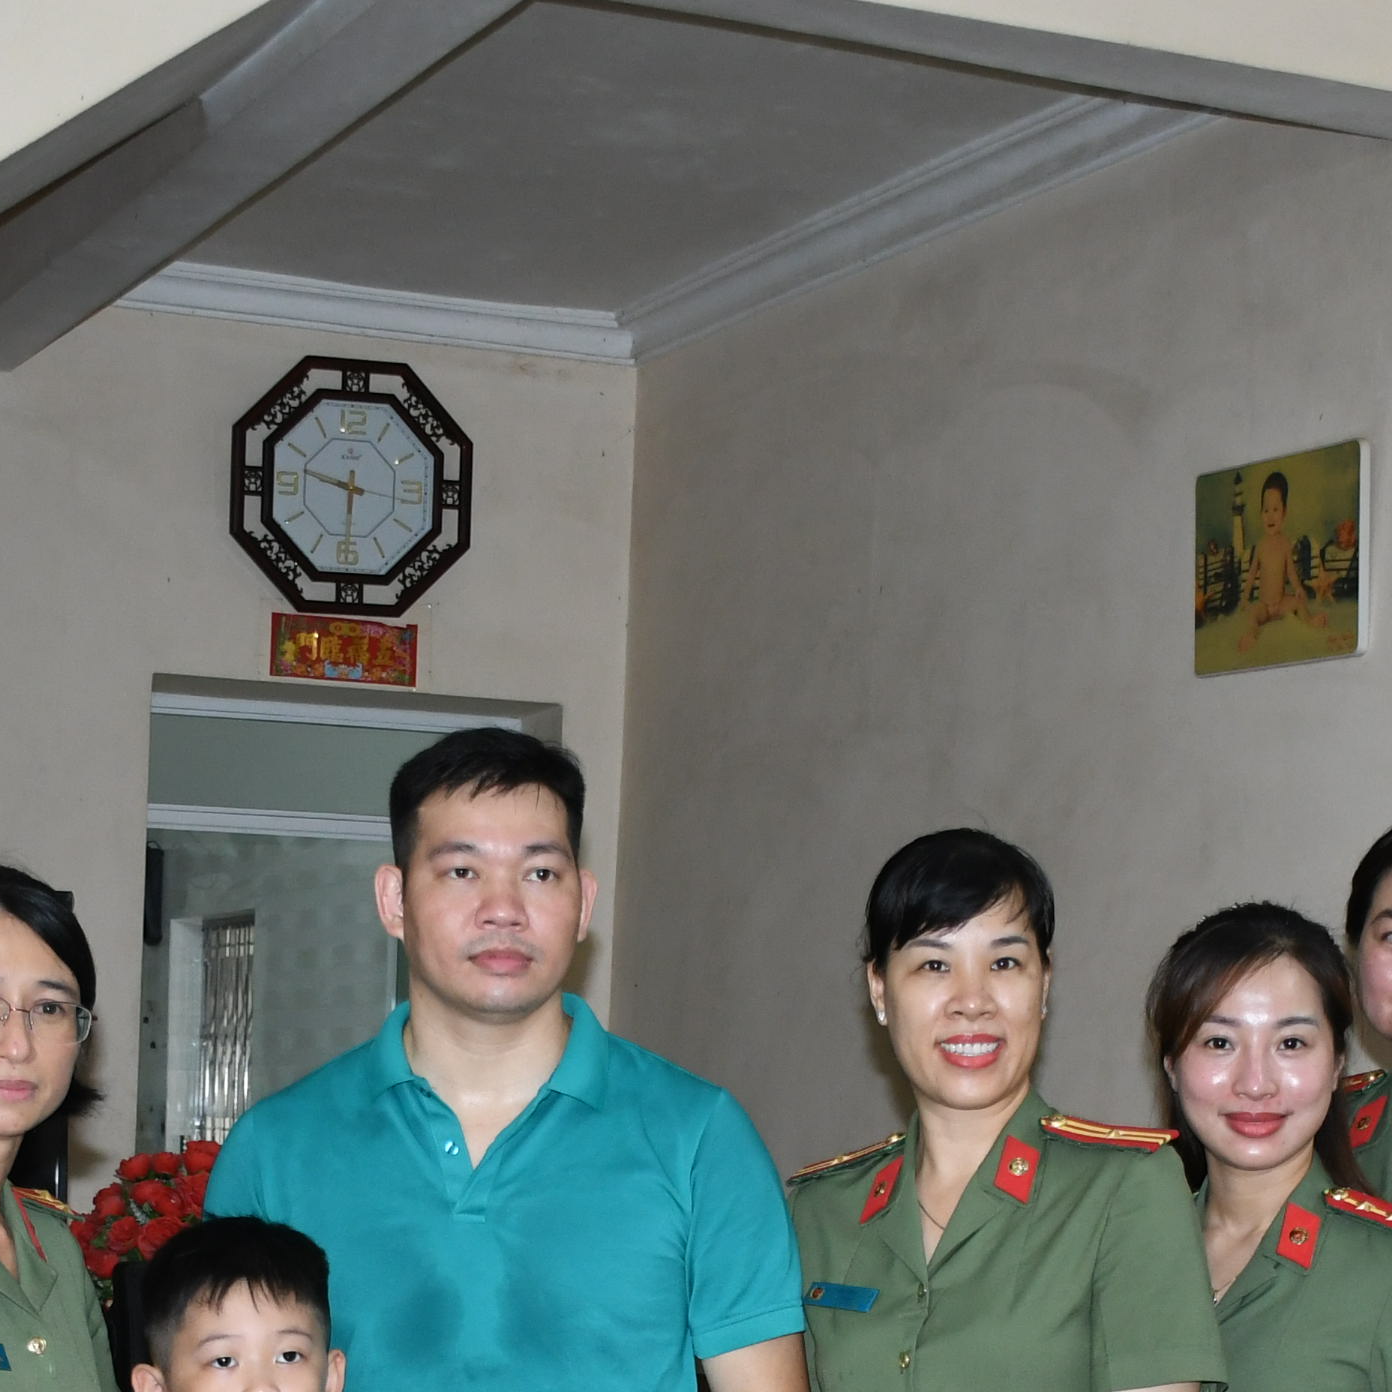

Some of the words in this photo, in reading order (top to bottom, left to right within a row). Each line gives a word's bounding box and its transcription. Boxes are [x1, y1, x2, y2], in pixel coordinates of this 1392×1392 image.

[340, 409, 368, 435] 12
[276, 470, 299, 496] 9
[399, 480, 423, 505] 3
[336, 540, 359, 566] 6
